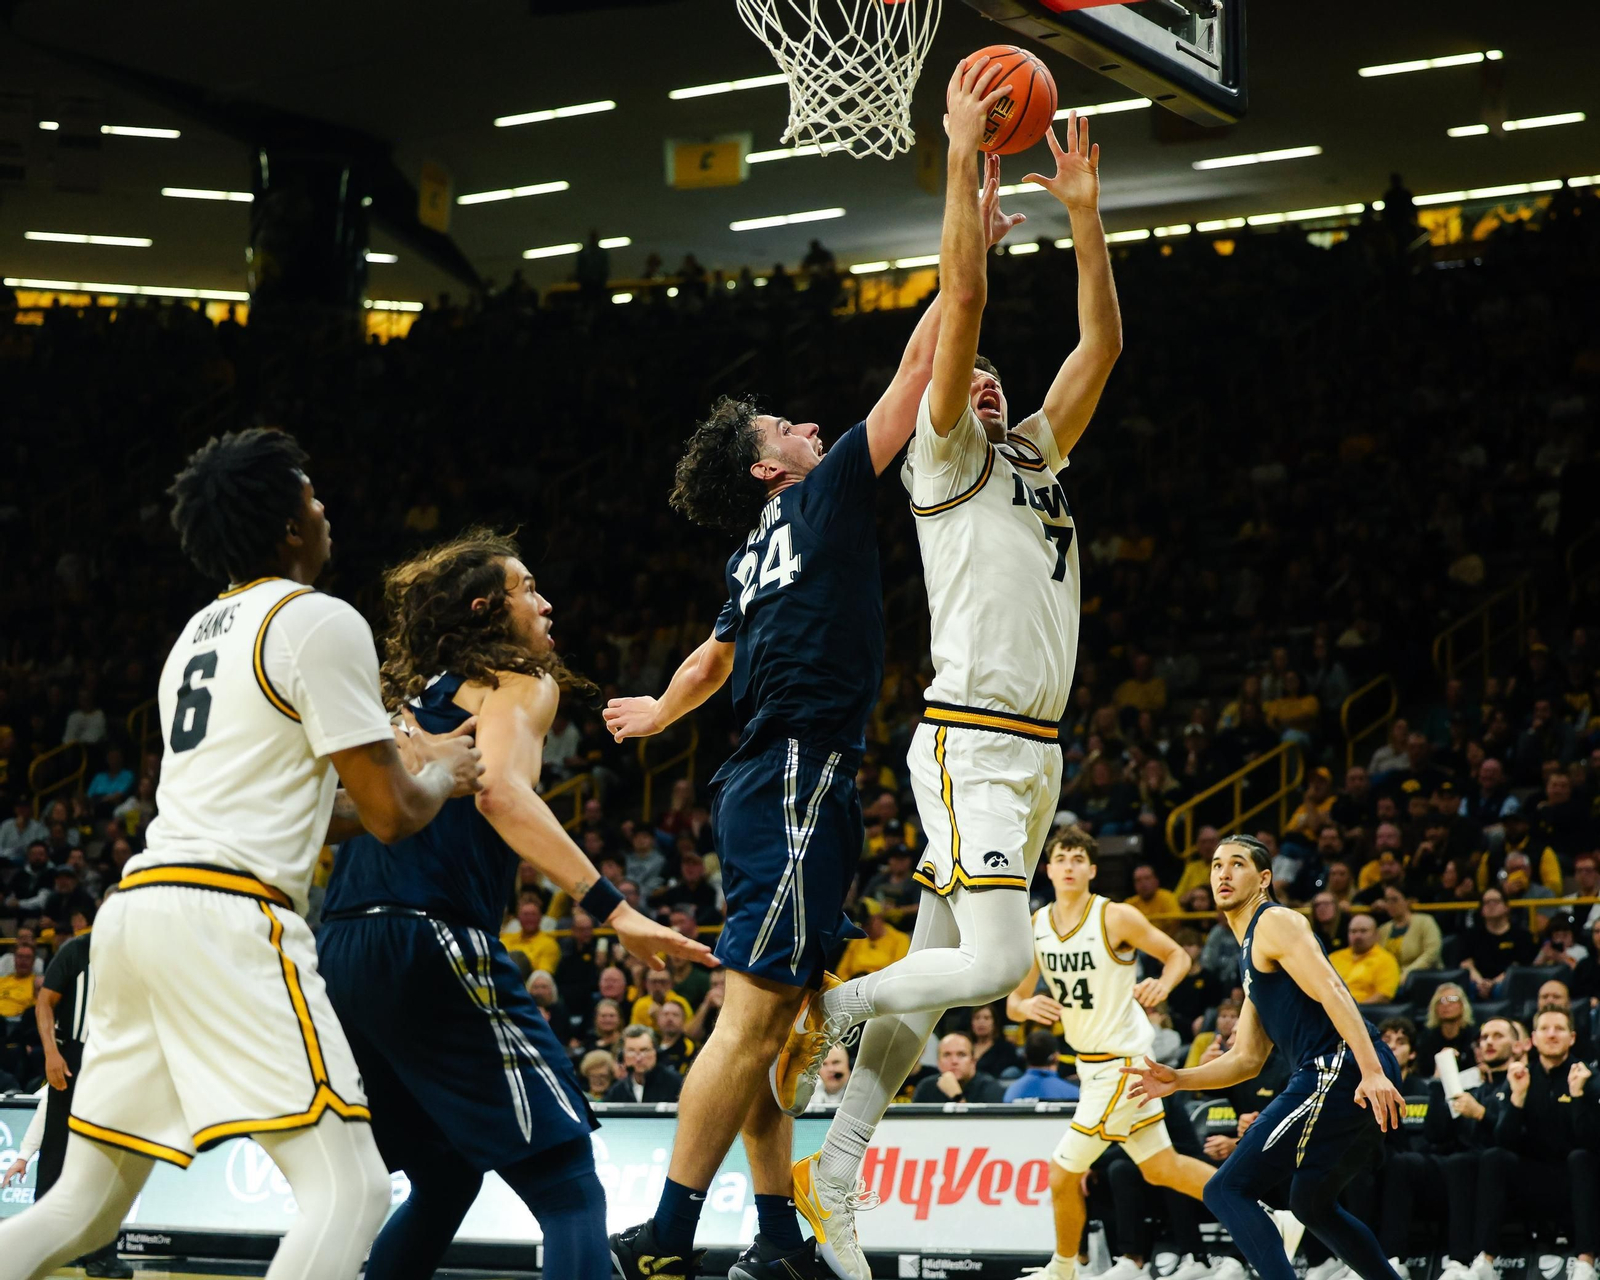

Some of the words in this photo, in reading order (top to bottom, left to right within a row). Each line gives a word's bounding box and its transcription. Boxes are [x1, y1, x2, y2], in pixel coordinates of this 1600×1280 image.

[1042, 522, 1074, 583] 7
[732, 523, 801, 616] 24
[193, 603, 242, 644] BANKS
[170, 650, 218, 754] 6
[1041, 951, 1096, 972] IOWA
[1052, 978, 1093, 1010] 24
[126, 1241, 144, 1251] Bank
[922, 1259, 983, 1271] MidWestOne
[922, 1268, 947, 1279] Bank
